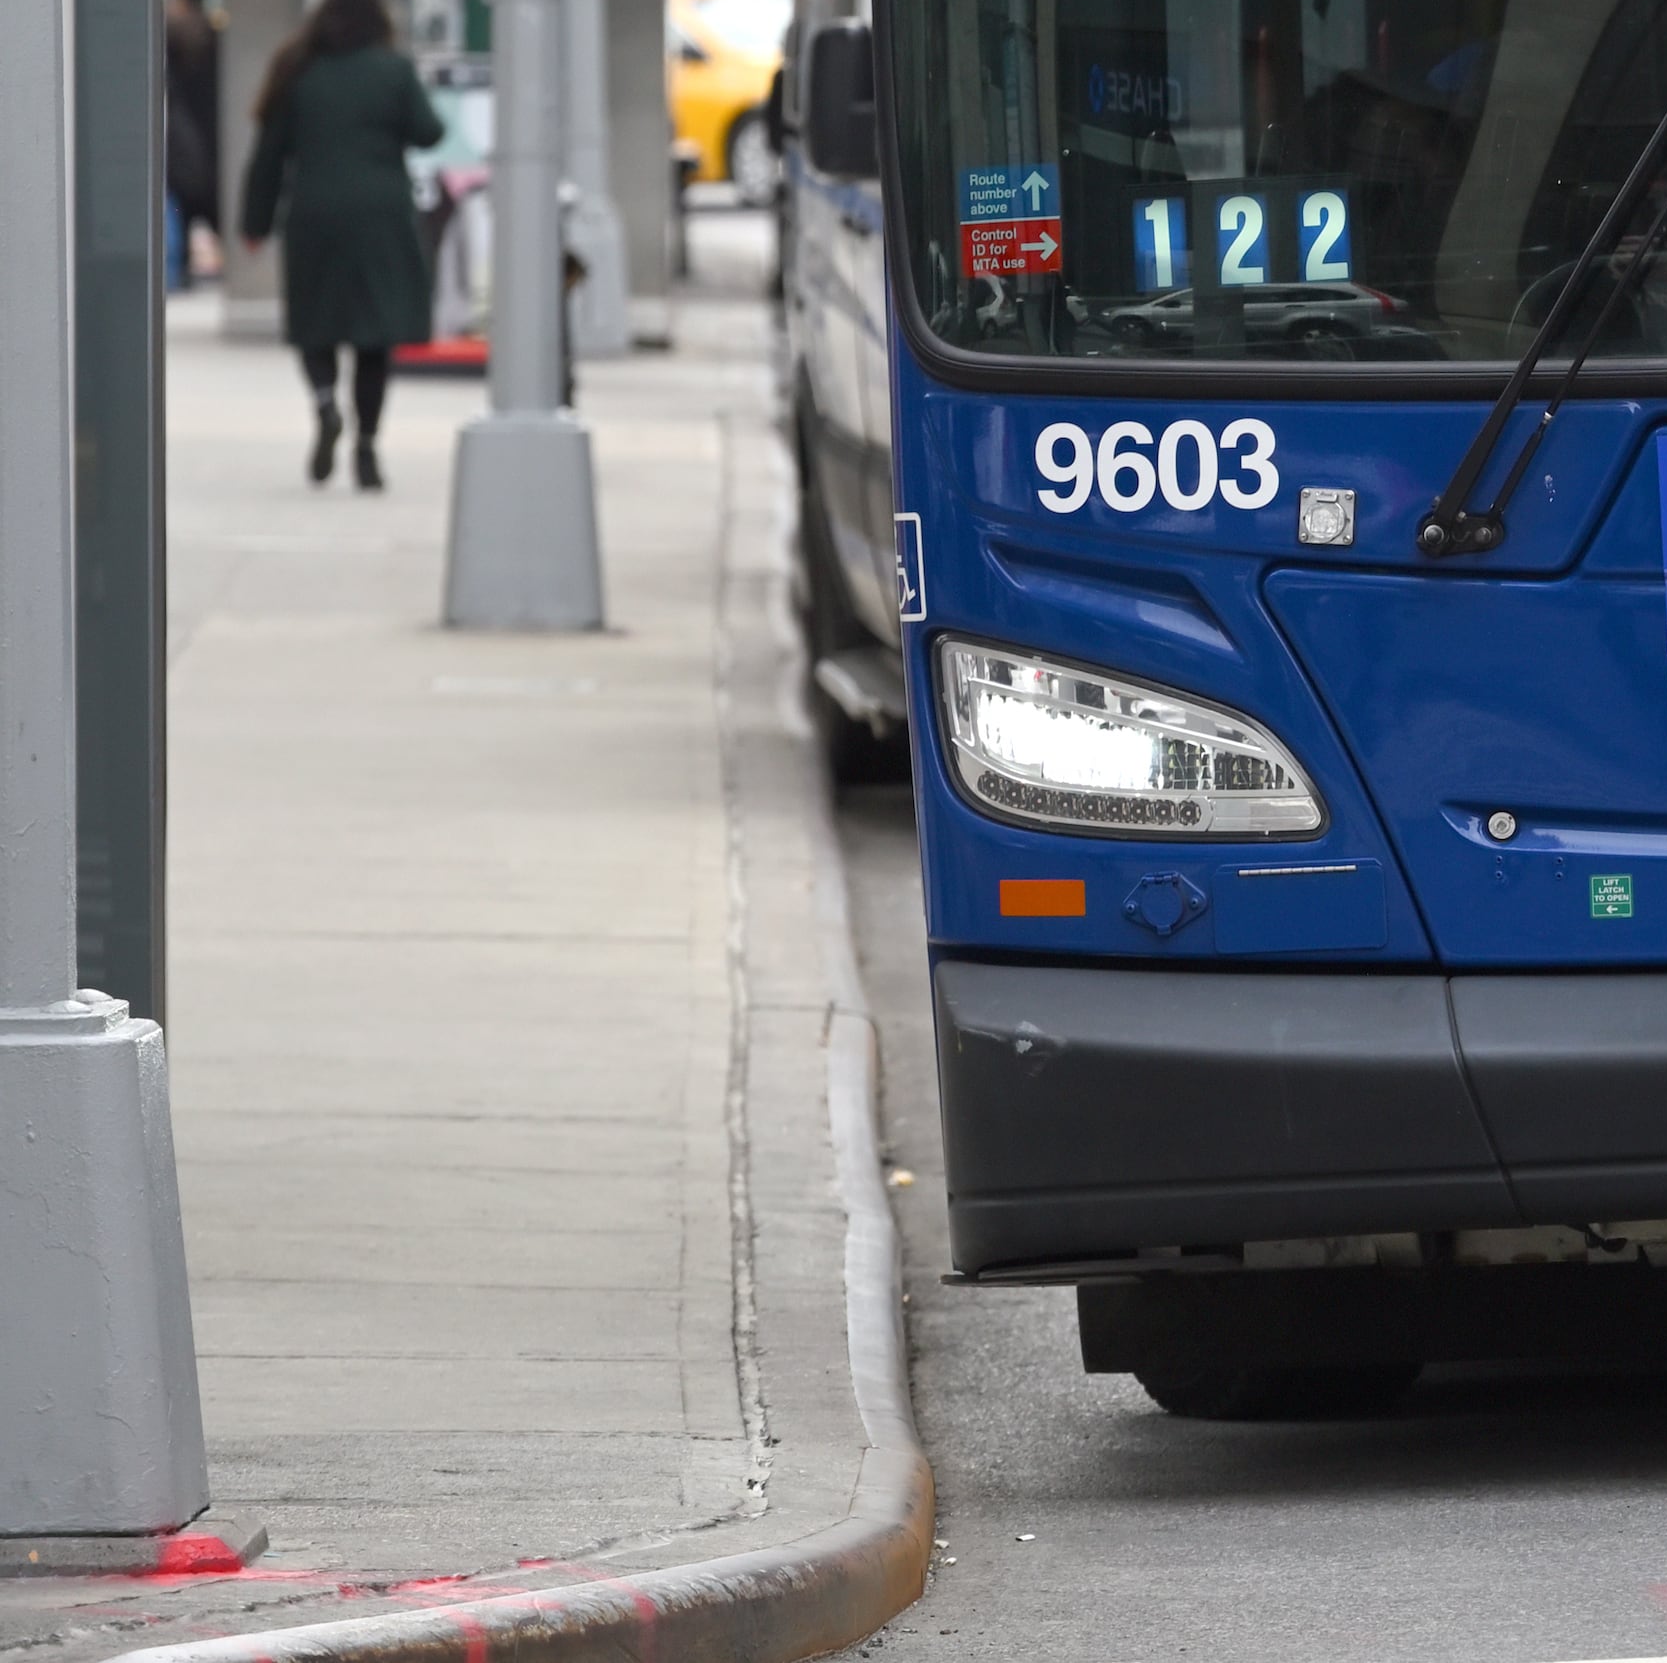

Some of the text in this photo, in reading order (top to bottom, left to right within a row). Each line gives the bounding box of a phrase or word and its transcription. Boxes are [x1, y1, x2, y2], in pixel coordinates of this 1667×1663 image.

[969, 174, 1006, 187] Route
[970, 187, 1017, 201] number
[970, 202, 1008, 215] above
[971, 227, 1017, 242] Control
[972, 243, 1007, 256] ID for
[973, 258, 1026, 271] MTA use
[1033, 417, 1280, 514] 9603
[1598, 886, 1625, 894] LATCH
[1606, 894, 1630, 902] OPEN
